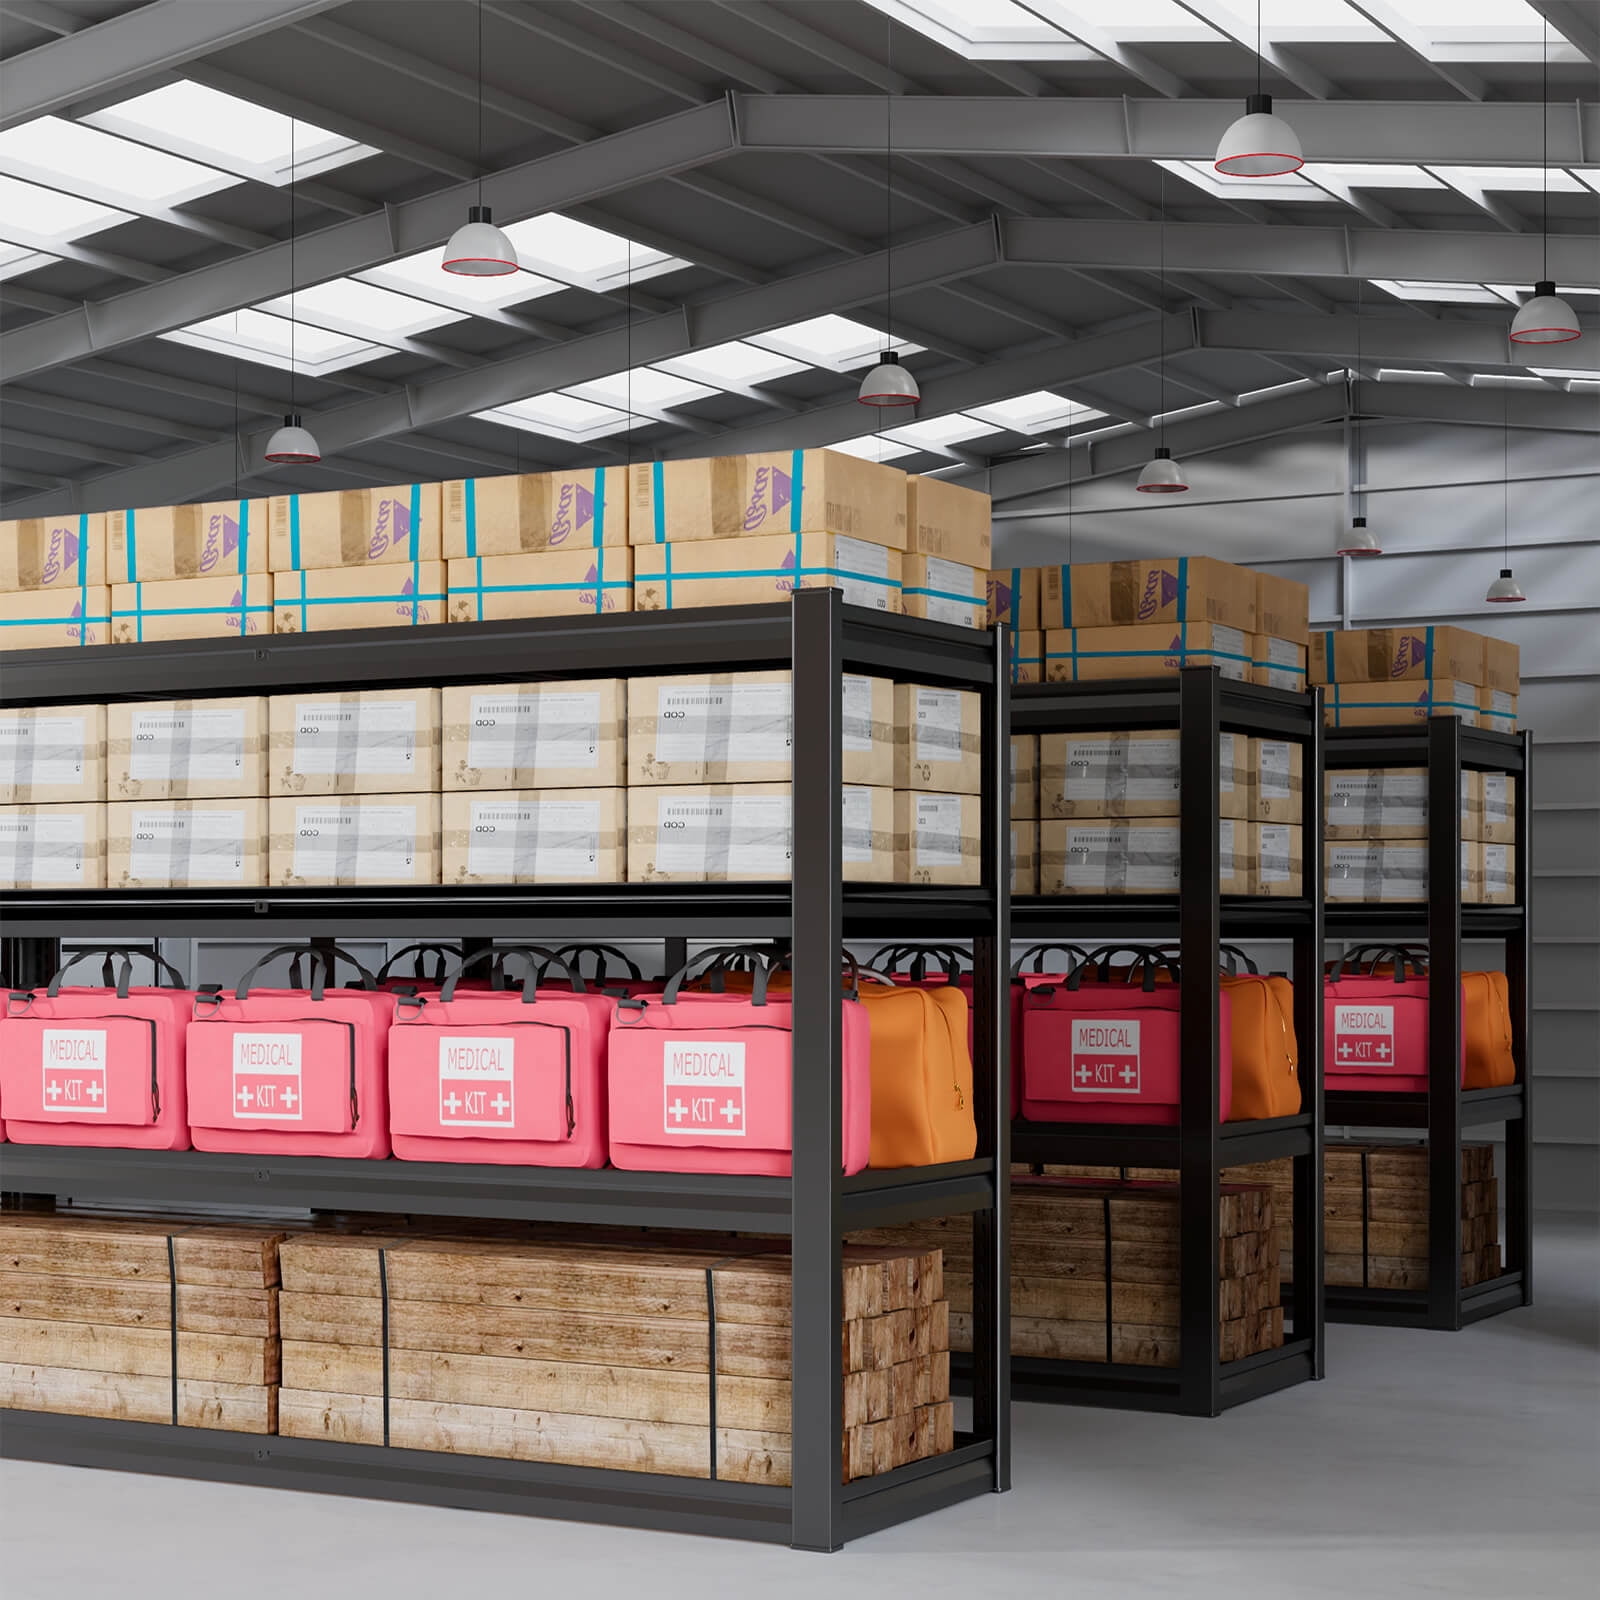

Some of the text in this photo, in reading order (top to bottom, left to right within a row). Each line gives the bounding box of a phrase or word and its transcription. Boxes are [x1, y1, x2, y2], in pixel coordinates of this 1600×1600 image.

[1341, 1012, 1387, 1029] MEDICAL
[1079, 1028, 1132, 1048] MEDICAL
[49, 1039, 98, 1061] MEDICAL
[240, 1043, 293, 1066] MEDICAL
[448, 1047, 505, 1071] MEDICAL
[1355, 1042, 1372, 1058] KIT
[673, 1052, 735, 1077] MEDICAL
[1095, 1063, 1115, 1083] KIT
[64, 1079, 83, 1101] KIT
[256, 1085, 276, 1108] KIT
[465, 1091, 487, 1114] KIT
[691, 1097, 716, 1122] KIT
